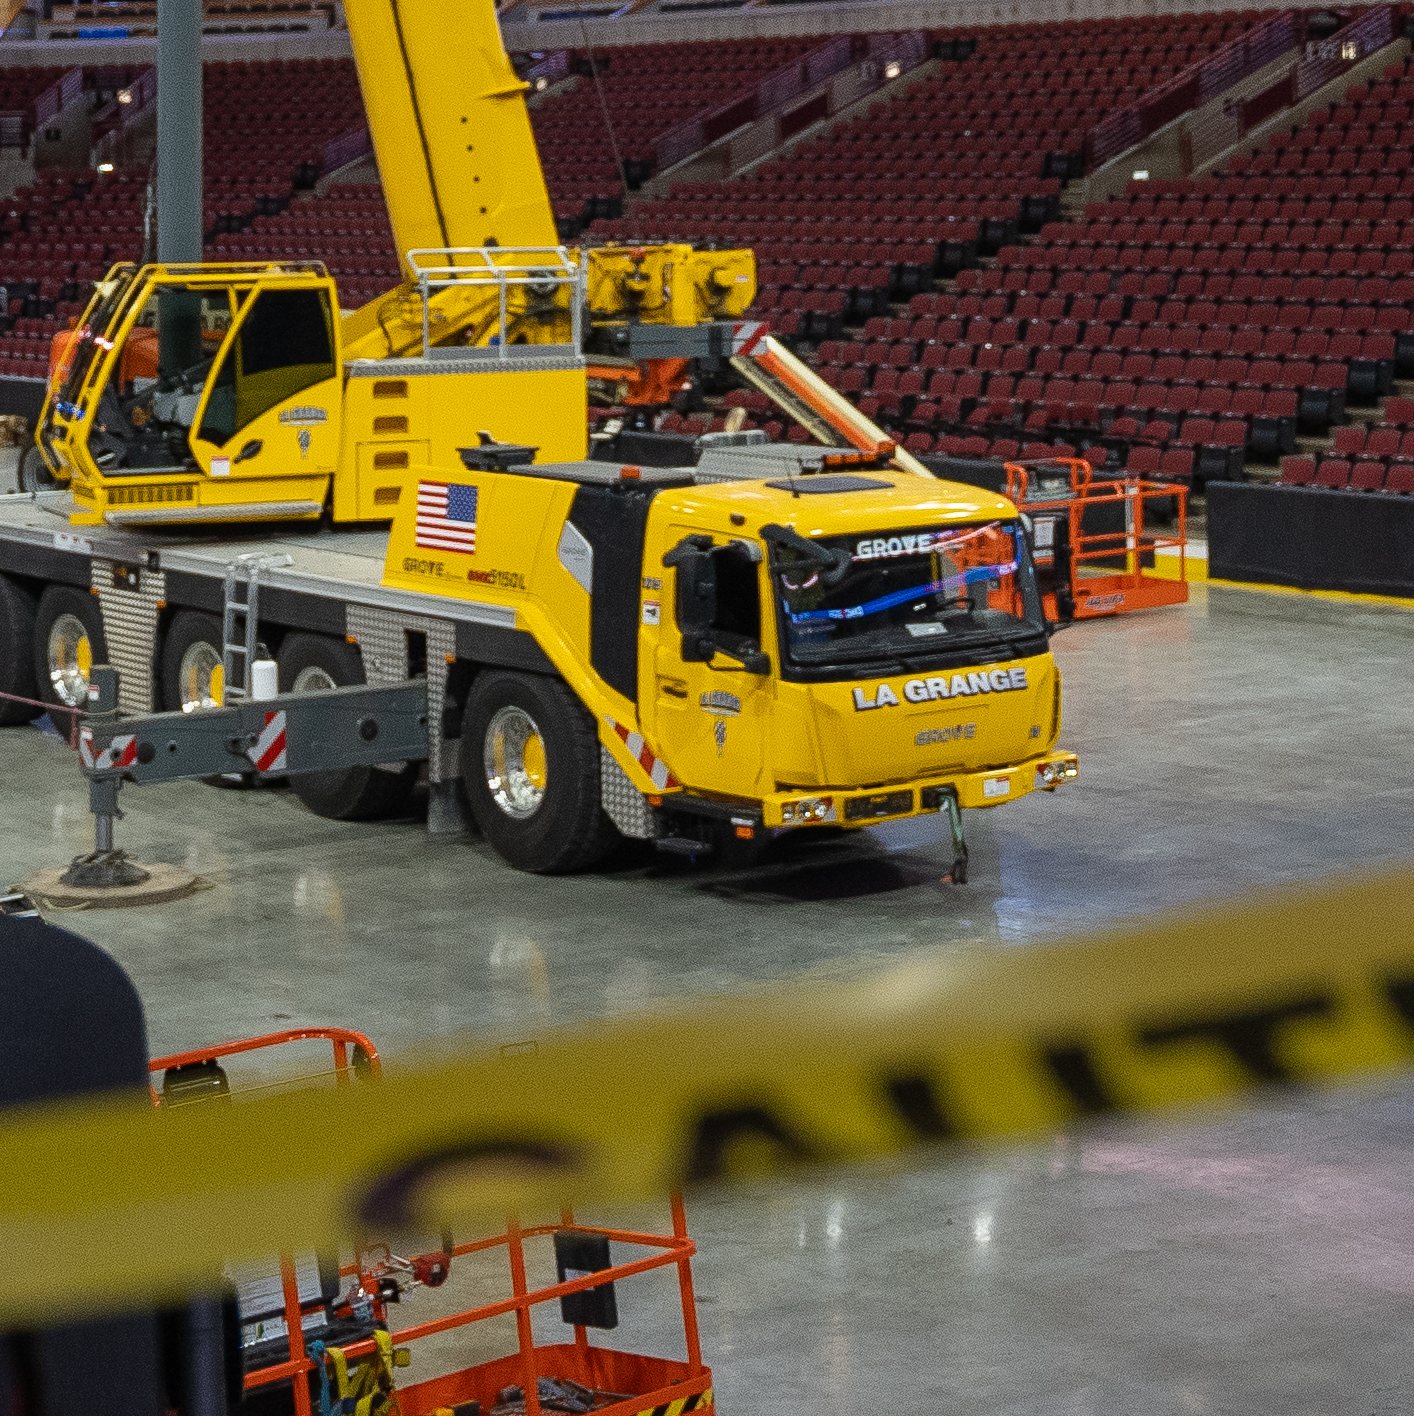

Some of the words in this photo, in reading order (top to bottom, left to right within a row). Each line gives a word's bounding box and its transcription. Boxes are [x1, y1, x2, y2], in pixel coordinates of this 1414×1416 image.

[856, 534, 933, 560] GROVE
[402, 556, 445, 577] GROVE
[852, 684, 899, 712] LA
[904, 668, 1028, 703] GRANGE
[914, 721, 977, 747] GROVE
